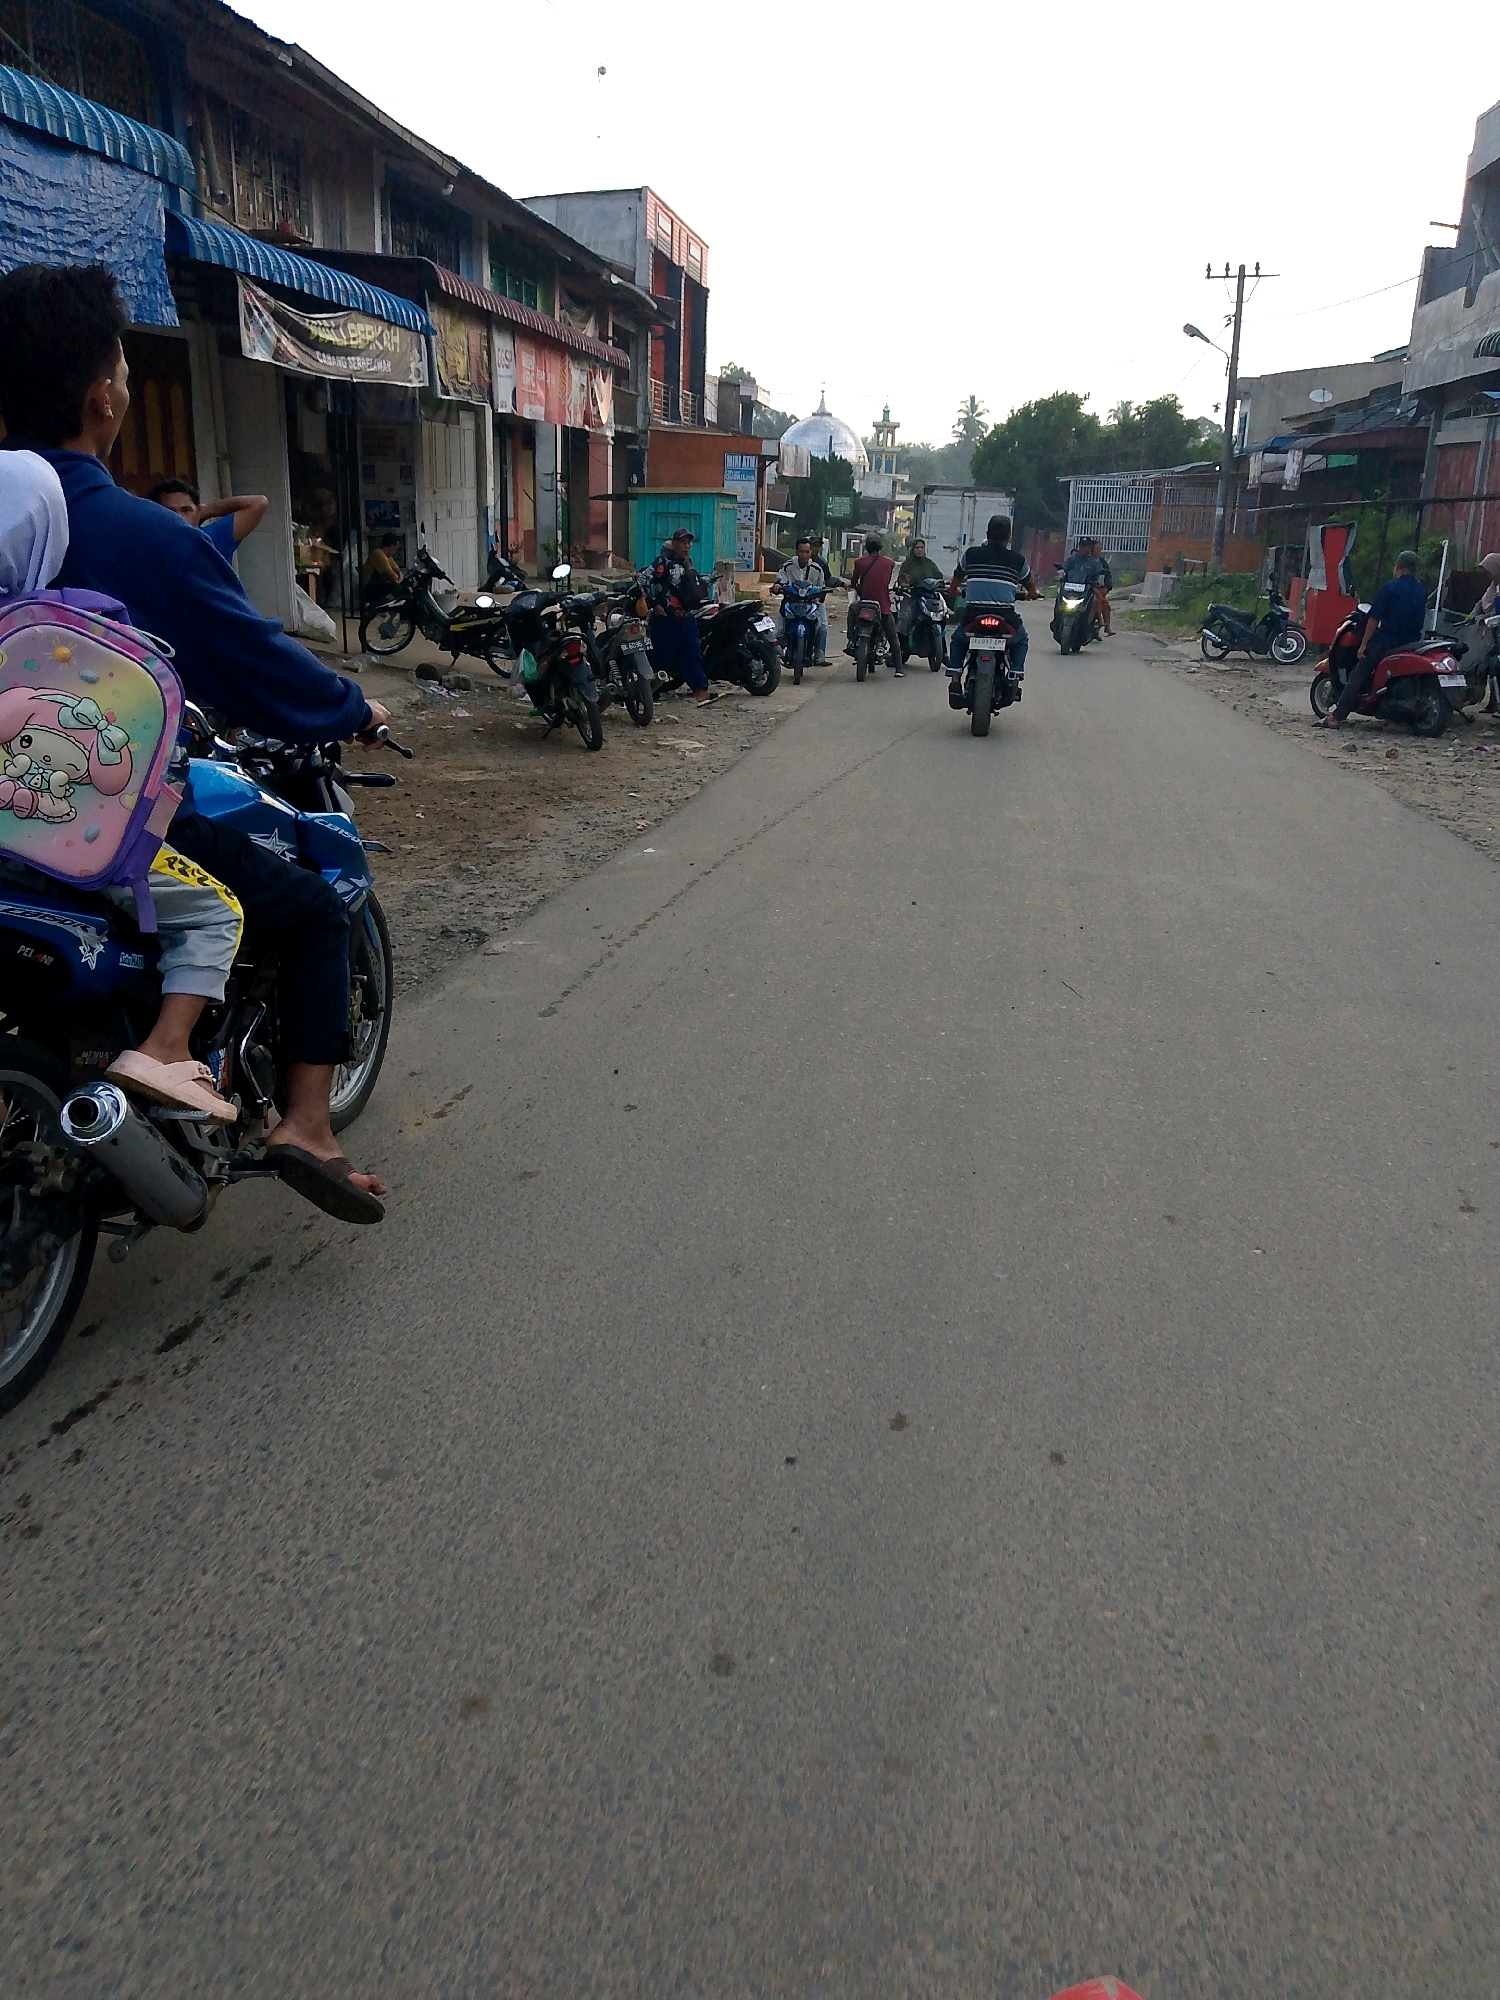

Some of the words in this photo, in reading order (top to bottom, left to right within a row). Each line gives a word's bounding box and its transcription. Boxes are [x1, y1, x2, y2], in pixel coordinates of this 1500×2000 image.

[315, 351, 347, 369] CABANG
[726, 454, 742, 468] MINI
[742, 455, 756, 468] ATM
